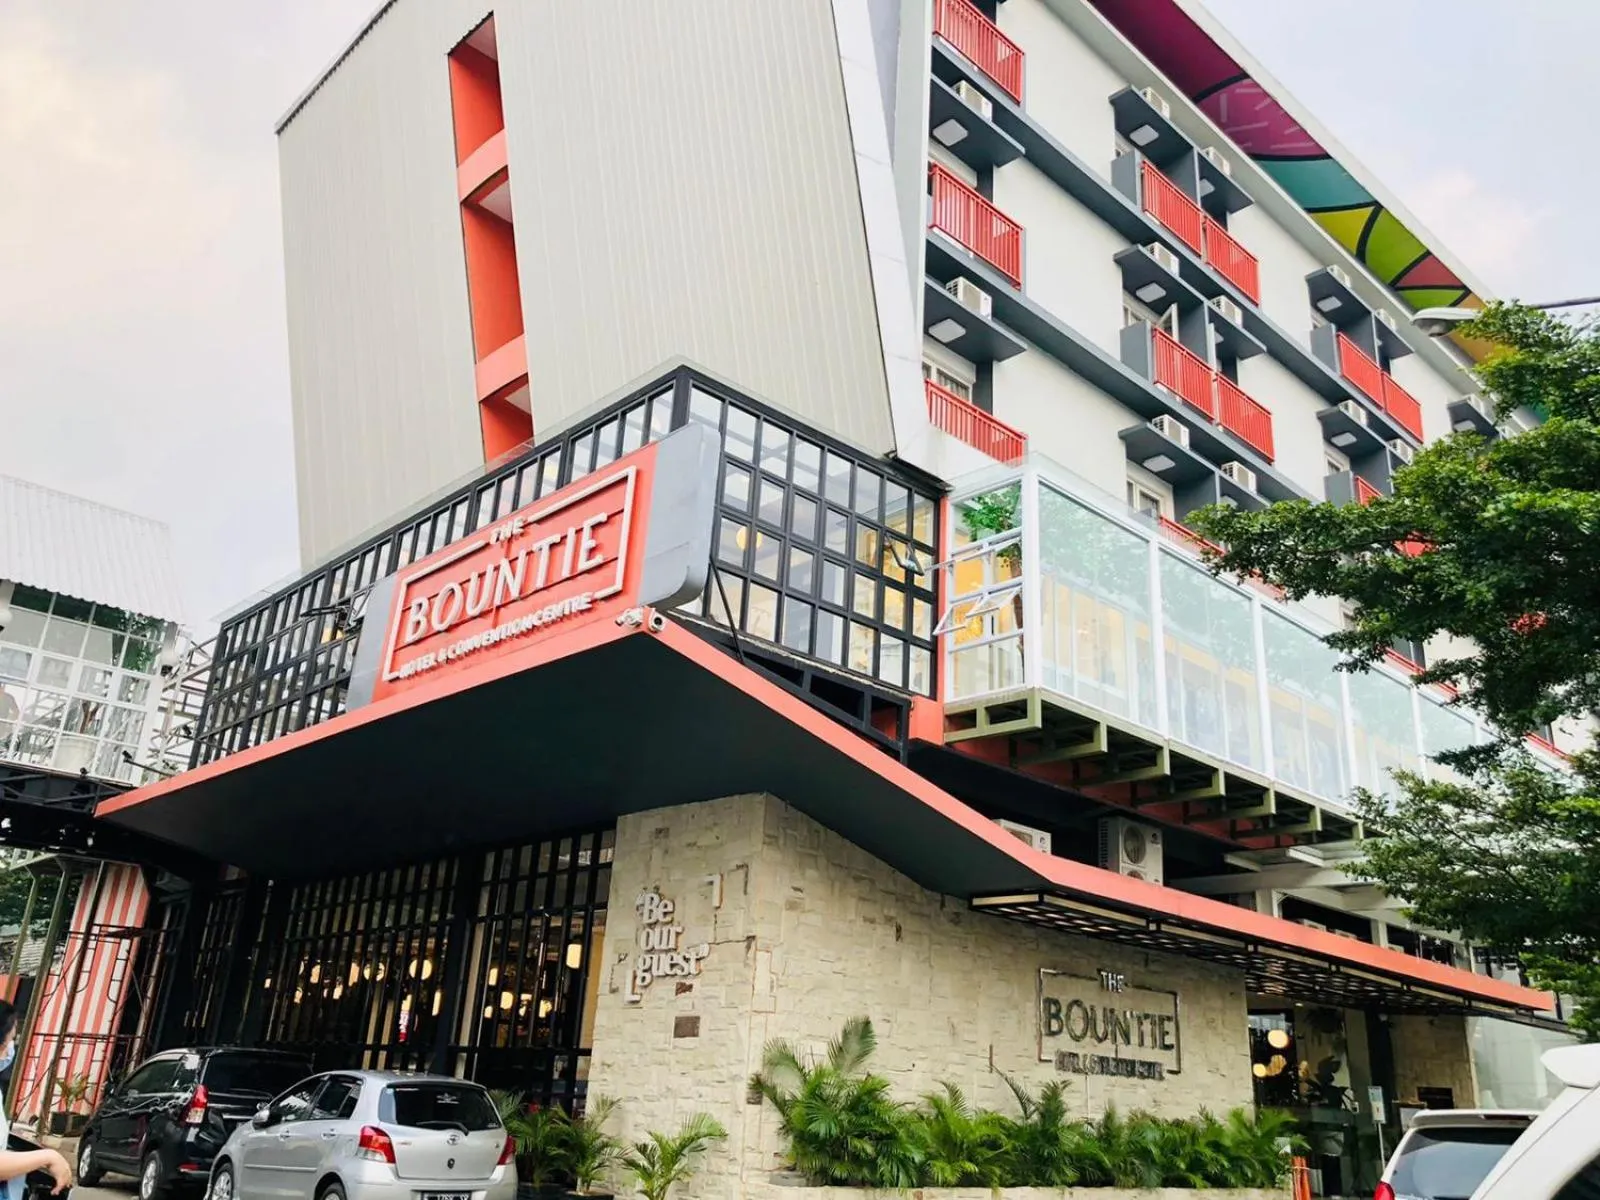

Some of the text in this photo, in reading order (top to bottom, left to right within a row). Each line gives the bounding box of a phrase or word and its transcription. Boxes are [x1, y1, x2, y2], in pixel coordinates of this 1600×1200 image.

[490, 516, 525, 544] THE
[405, 512, 607, 643] BOUNTIE
[641, 925, 683, 951] our
[1099, 971, 1125, 993] THE
[1042, 997, 1175, 1051] BOUNTIE
